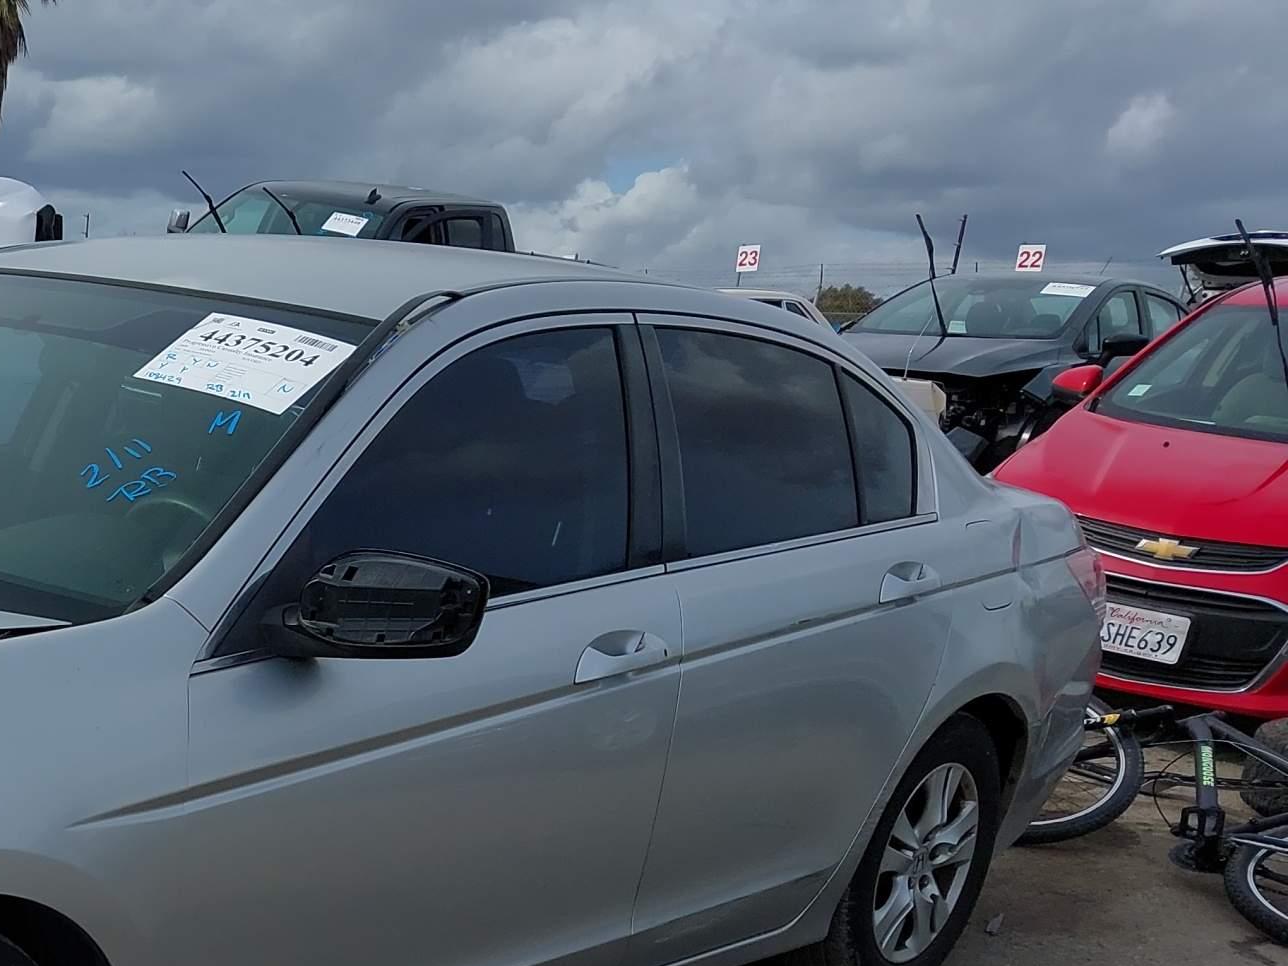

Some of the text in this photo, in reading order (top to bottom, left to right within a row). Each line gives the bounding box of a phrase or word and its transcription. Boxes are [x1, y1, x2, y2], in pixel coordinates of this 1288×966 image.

[737, 250, 759, 268] 23
[1018, 250, 1043, 268] 22
[199, 329, 321, 368] 44375204
[208, 410, 241, 435] M
[1108, 606, 1169, 629] California
[1100, 622, 1178, 655] SHE639
[1200, 745, 1215, 787] MONGOOSE
